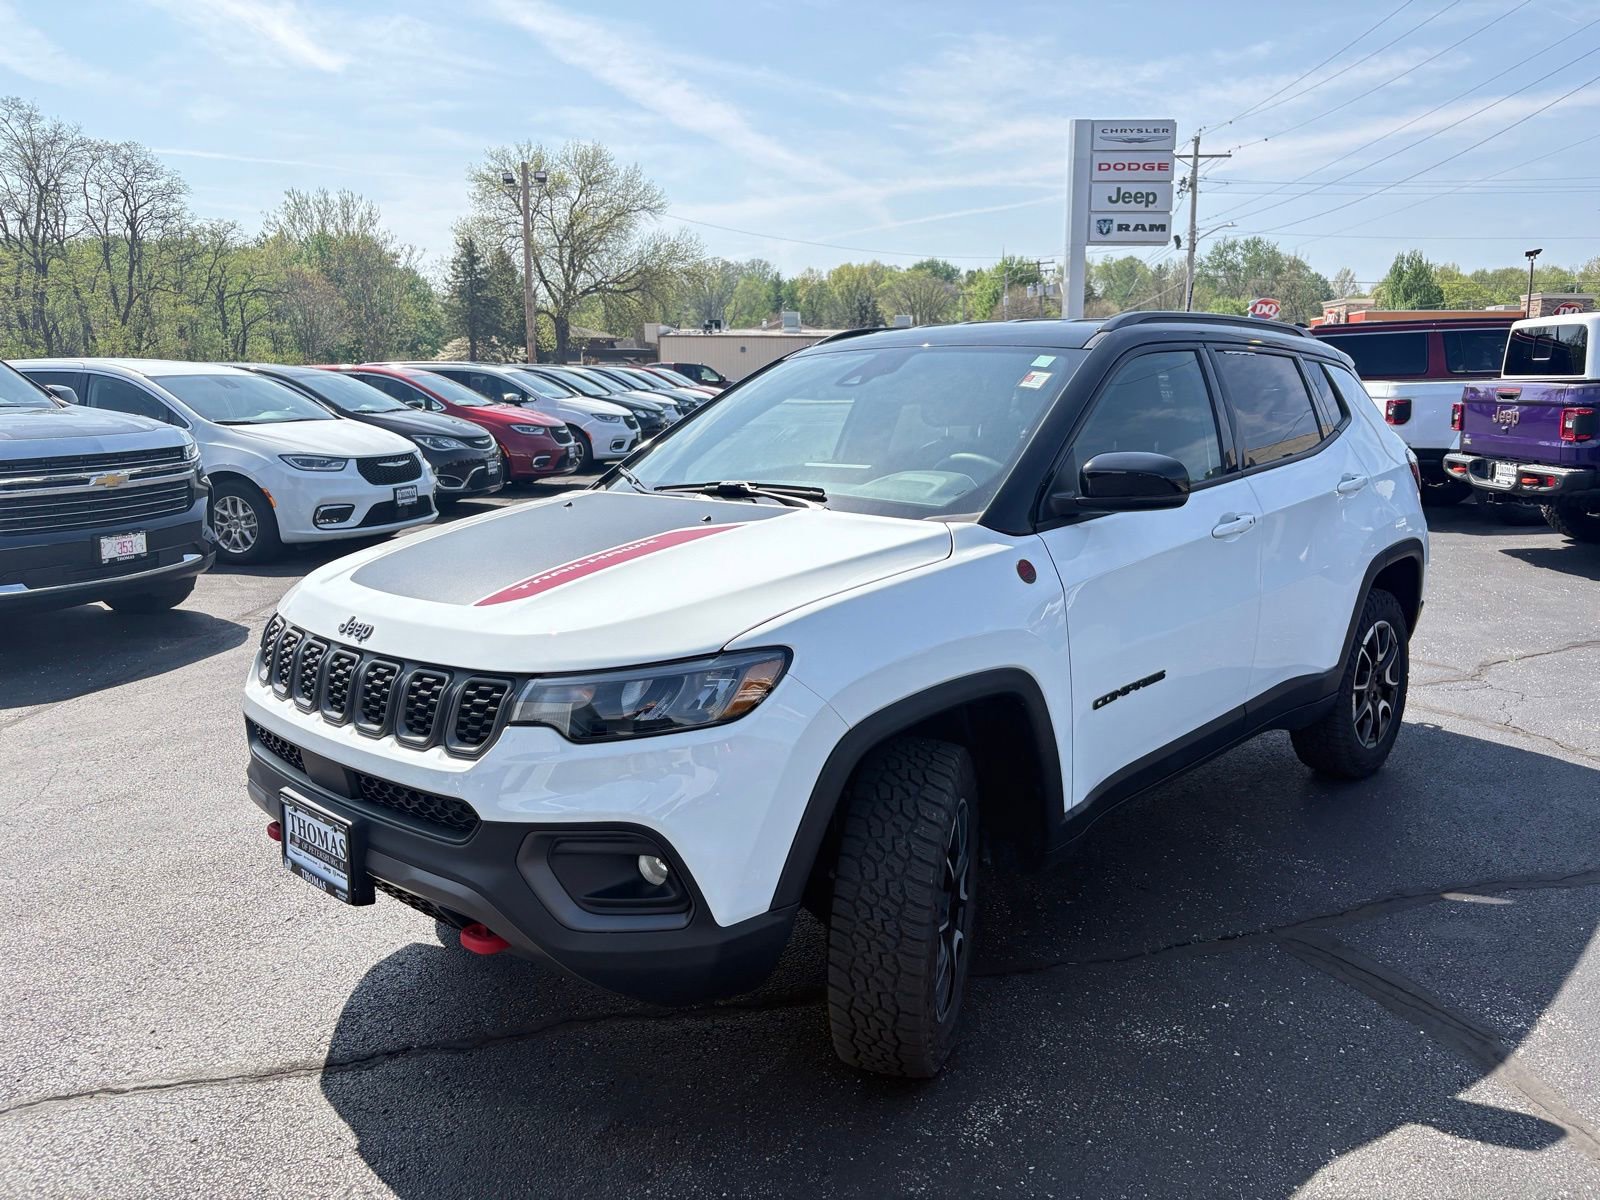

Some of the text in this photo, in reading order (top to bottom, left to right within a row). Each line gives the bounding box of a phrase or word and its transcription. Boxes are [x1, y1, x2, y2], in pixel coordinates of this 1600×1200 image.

[1098, 162, 1170, 172] DODGE
[1107, 186, 1158, 208] Jeep
[1117, 223, 1167, 232] RAM
[1254, 303, 1277, 316] DQ
[1492, 406, 1520, 428] Jeep
[511, 538, 660, 592] TRAILHAWK
[338, 616, 375, 645] Jeep
[1092, 670, 1166, 710] COMPASS
[288, 812, 347, 860] THOMAS
[301, 868, 327, 891] THOMAS
